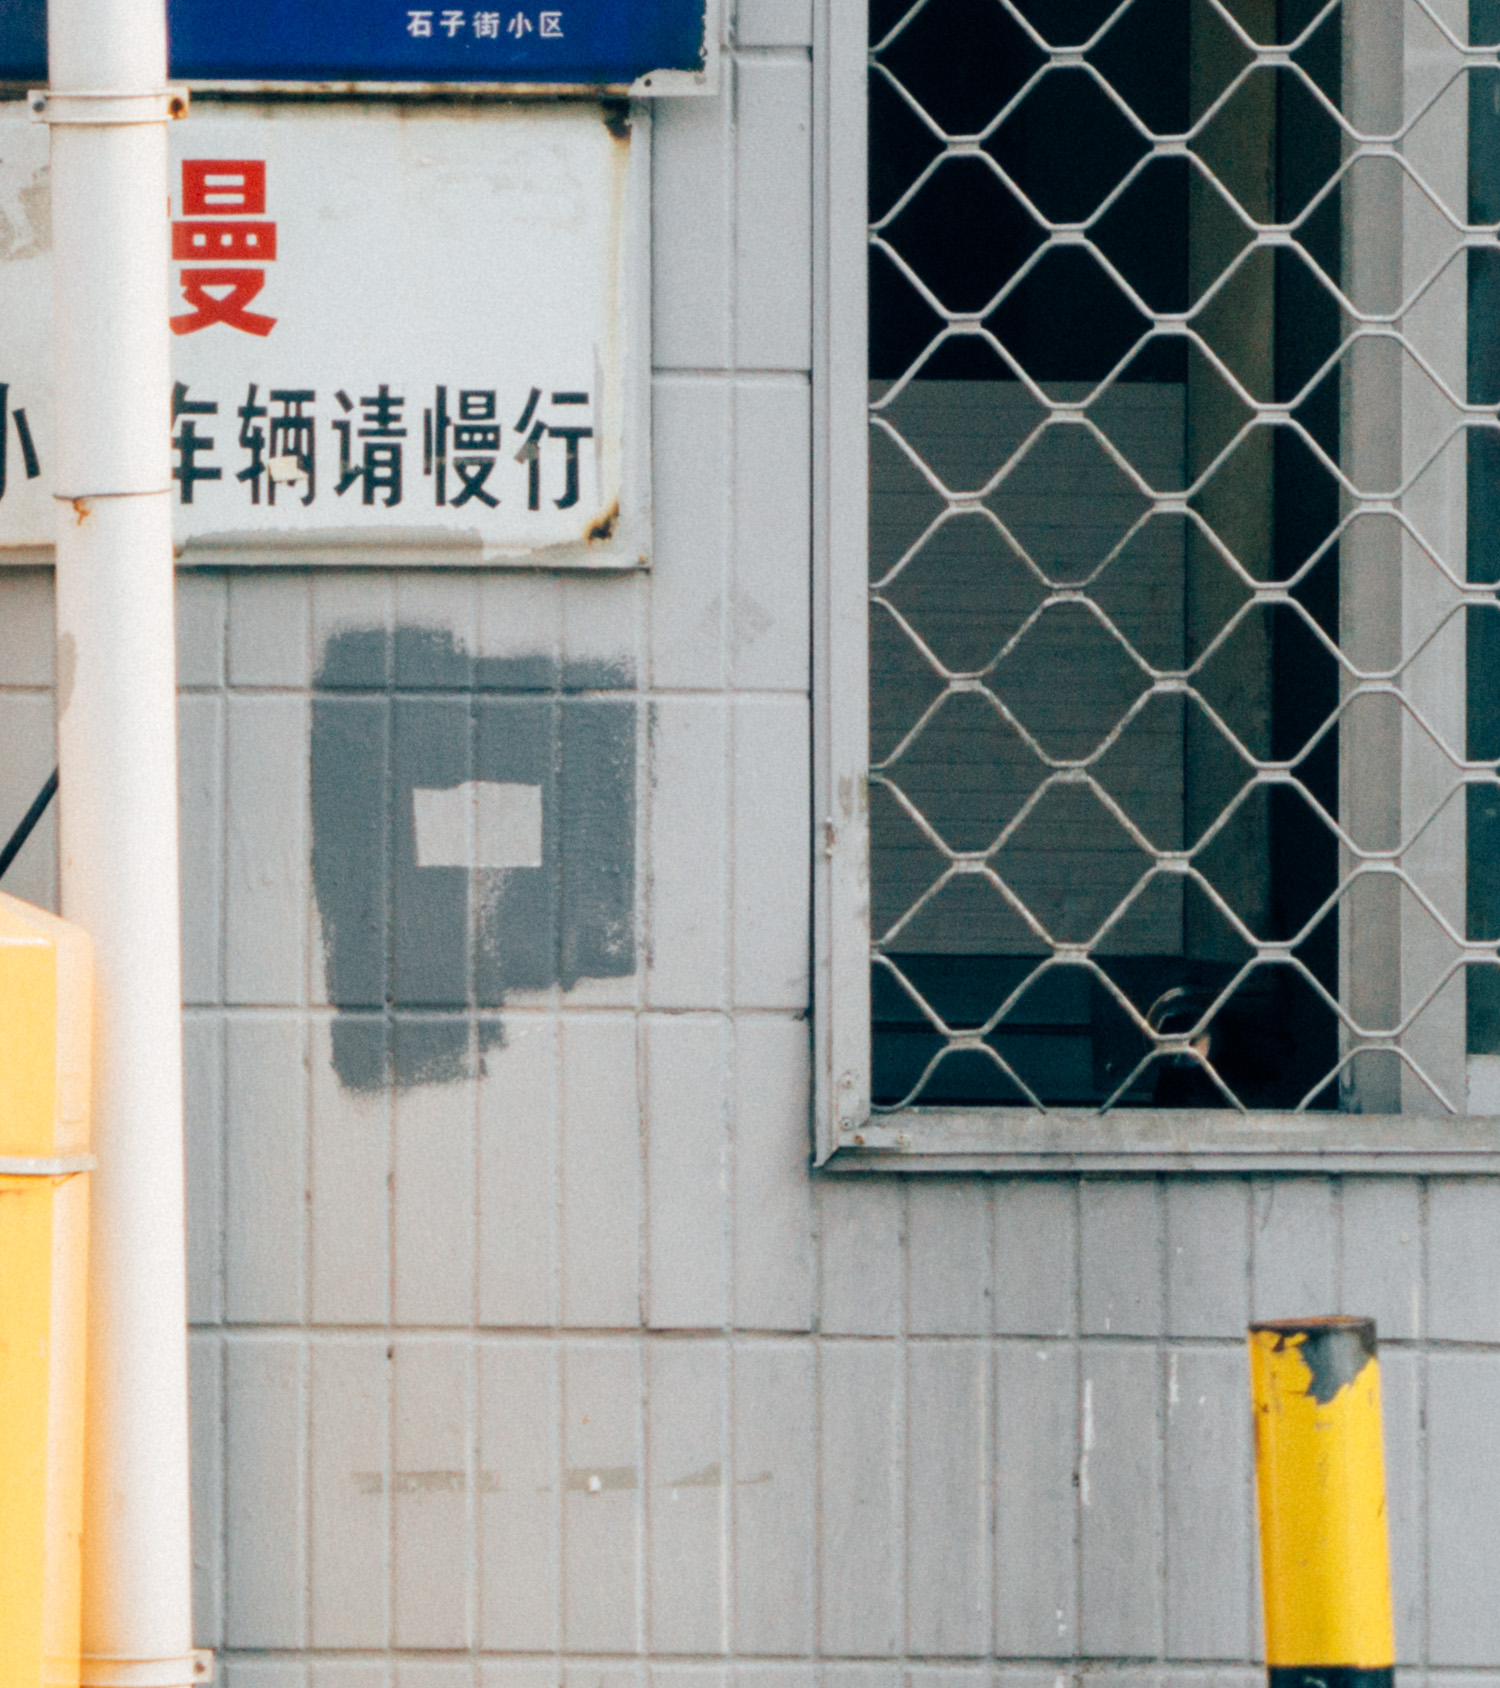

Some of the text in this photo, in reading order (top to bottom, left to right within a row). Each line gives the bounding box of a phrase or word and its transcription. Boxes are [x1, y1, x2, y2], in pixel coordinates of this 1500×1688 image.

[407, 10, 564, 39] 石子街小区
